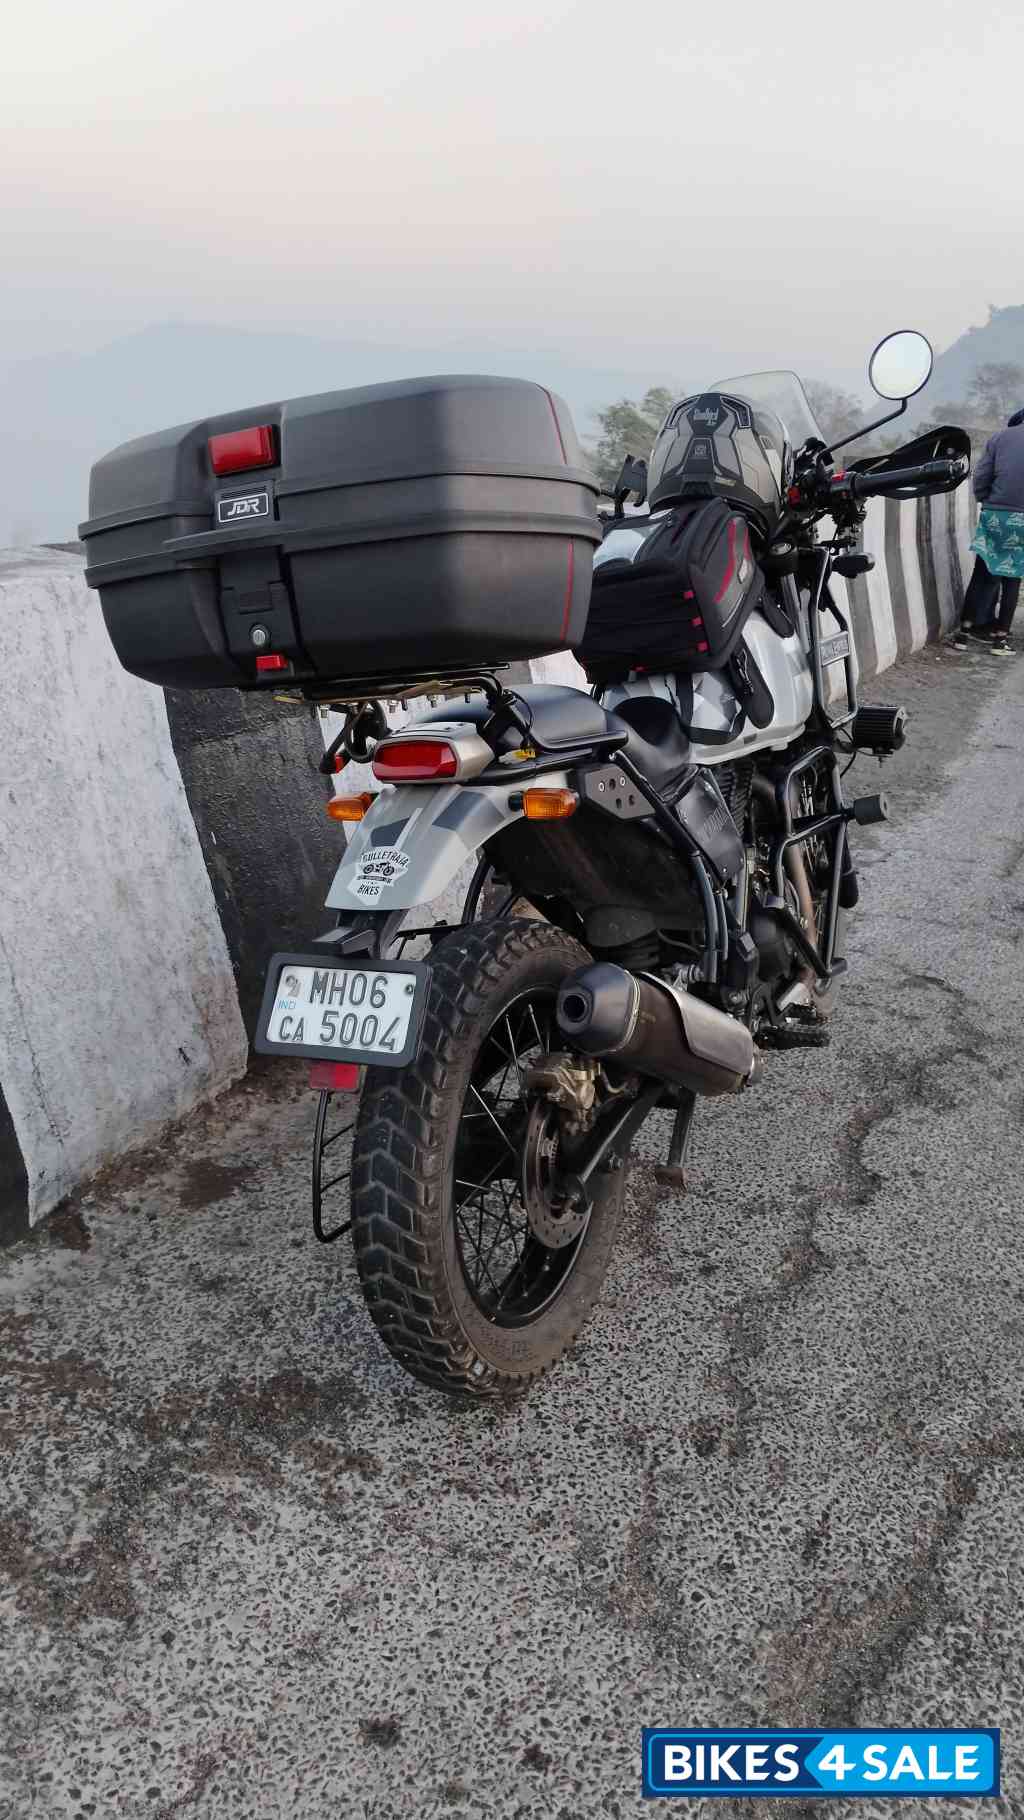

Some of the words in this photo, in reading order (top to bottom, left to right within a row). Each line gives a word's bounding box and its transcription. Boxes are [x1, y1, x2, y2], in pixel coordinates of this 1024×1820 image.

[227, 498, 260, 516] JDR
[357, 884, 380, 896] BIKES
[309, 970, 388, 1008] MH06
[278, 999, 296, 1009] IND
[279, 1016, 304, 1041] CA
[320, 1010, 400, 1051] 5004
